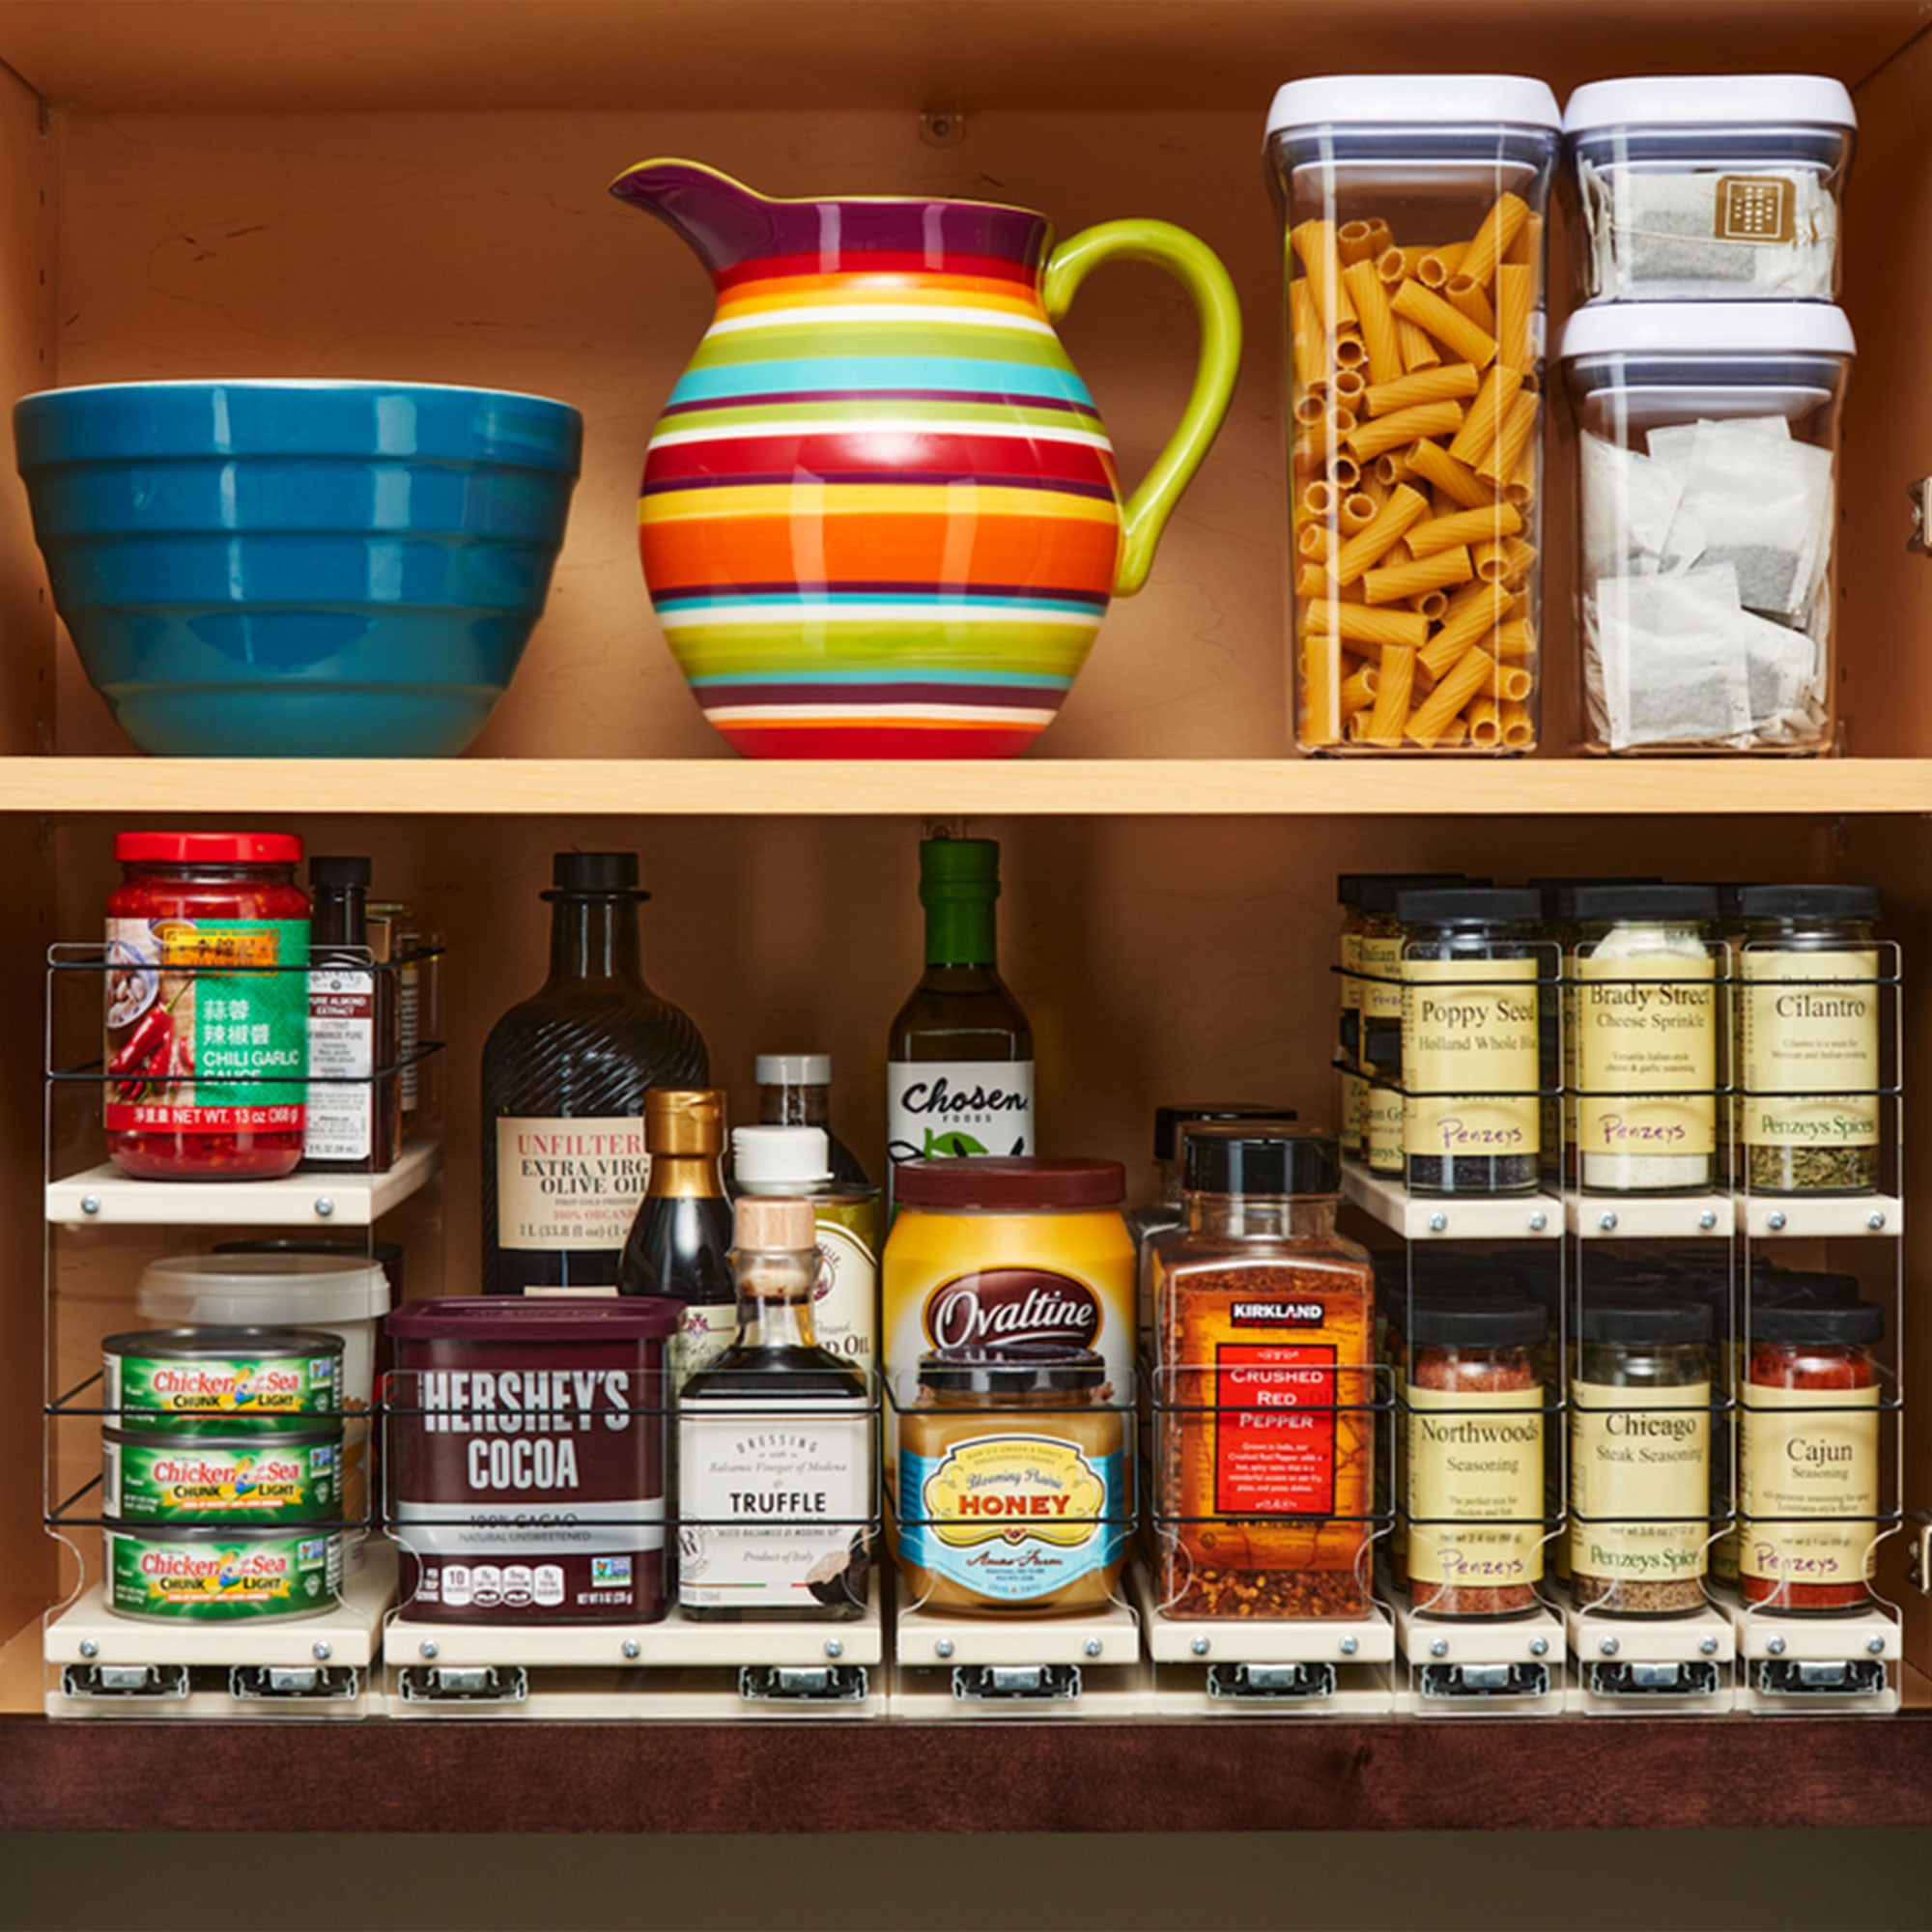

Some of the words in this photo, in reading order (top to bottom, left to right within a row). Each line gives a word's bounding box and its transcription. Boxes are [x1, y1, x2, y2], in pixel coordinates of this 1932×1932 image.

[1591, 983, 1653, 1011] Brady
[1660, 983, 1711, 1006] Street
[1776, 994, 1865, 1017] Cilantro
[1422, 1000, 1490, 1027] Poppy
[1596, 1013, 1646, 1029] Cheese
[1651, 1013, 1705, 1031] Sprinkle
[1419, 1036, 1471, 1051] Holland
[1478, 1036, 1517, 1051] Whole
[203, 1051, 248, 1066] CHILI
[251, 1050, 300, 1065] GARLIC
[901, 1076, 1029, 1113] Chosen
[173, 1109, 201, 1123] NET
[204, 1109, 231, 1124] WT.
[236, 1108, 250, 1123] 13
[252, 1111, 267, 1123] oz
[942, 1114, 992, 1123] FOODS
[1437, 1118, 1523, 1148] Penzeys
[1598, 1113, 1686, 1145] Penzeys
[1762, 1115, 1832, 1141] Penzeys
[1833, 1115, 1875, 1140] Spices
[518, 1134, 641, 1156] UNFILTER
[522, 1159, 589, 1177] EXTRA
[597, 1159, 649, 1177] VIRG
[541, 1177, 607, 1194] OLIVE
[935, 1288, 1094, 1350] Ovaltine
[1234, 1303, 1322, 1320] KIRKLAND
[153, 1370, 235, 1394] Chicken
[267, 1371, 299, 1392] Sea
[1230, 1367, 1323, 1383] CRUSHED
[173, 1394, 221, 1408] CHUNK
[258, 1394, 294, 1407] LIGHT
[424, 1370, 630, 1434] HERSHEY'S
[1257, 1390, 1297, 1406] RED
[1239, 1412, 1314, 1429] PEPPER
[1420, 1418, 1539, 1444] Northwoods
[1605, 1413, 1697, 1440] Chicago
[1596, 1445, 1634, 1463] Steak
[1786, 1437, 1853, 1467] Cajun
[153, 1461, 236, 1485] Chicken
[267, 1462, 299, 1482] Sea
[468, 1437, 579, 1490] COCOA
[1446, 1456, 1520, 1475] Seasoning
[1791, 1466, 1849, 1482] Seasoning
[173, 1485, 221, 1498] CHUNK
[258, 1484, 295, 1496] LIGHT
[730, 1492, 826, 1514] TRUFFLE
[958, 1494, 1070, 1516] HONEY
[458, 1531, 508, 1544] NATURAL
[509, 1530, 592, 1543] UNSWEETENED
[141, 1553, 220, 1577] Chicken
[251, 1555, 287, 1575] Sea
[1437, 1548, 1524, 1578] Penzeys
[1590, 1545, 1661, 1575] Penzeys
[1753, 1541, 1838, 1578] Penzeys
[159, 1577, 206, 1591] CHUNK
[243, 1577, 281, 1590] LIGHT
[449, 1571, 465, 1585] 10
